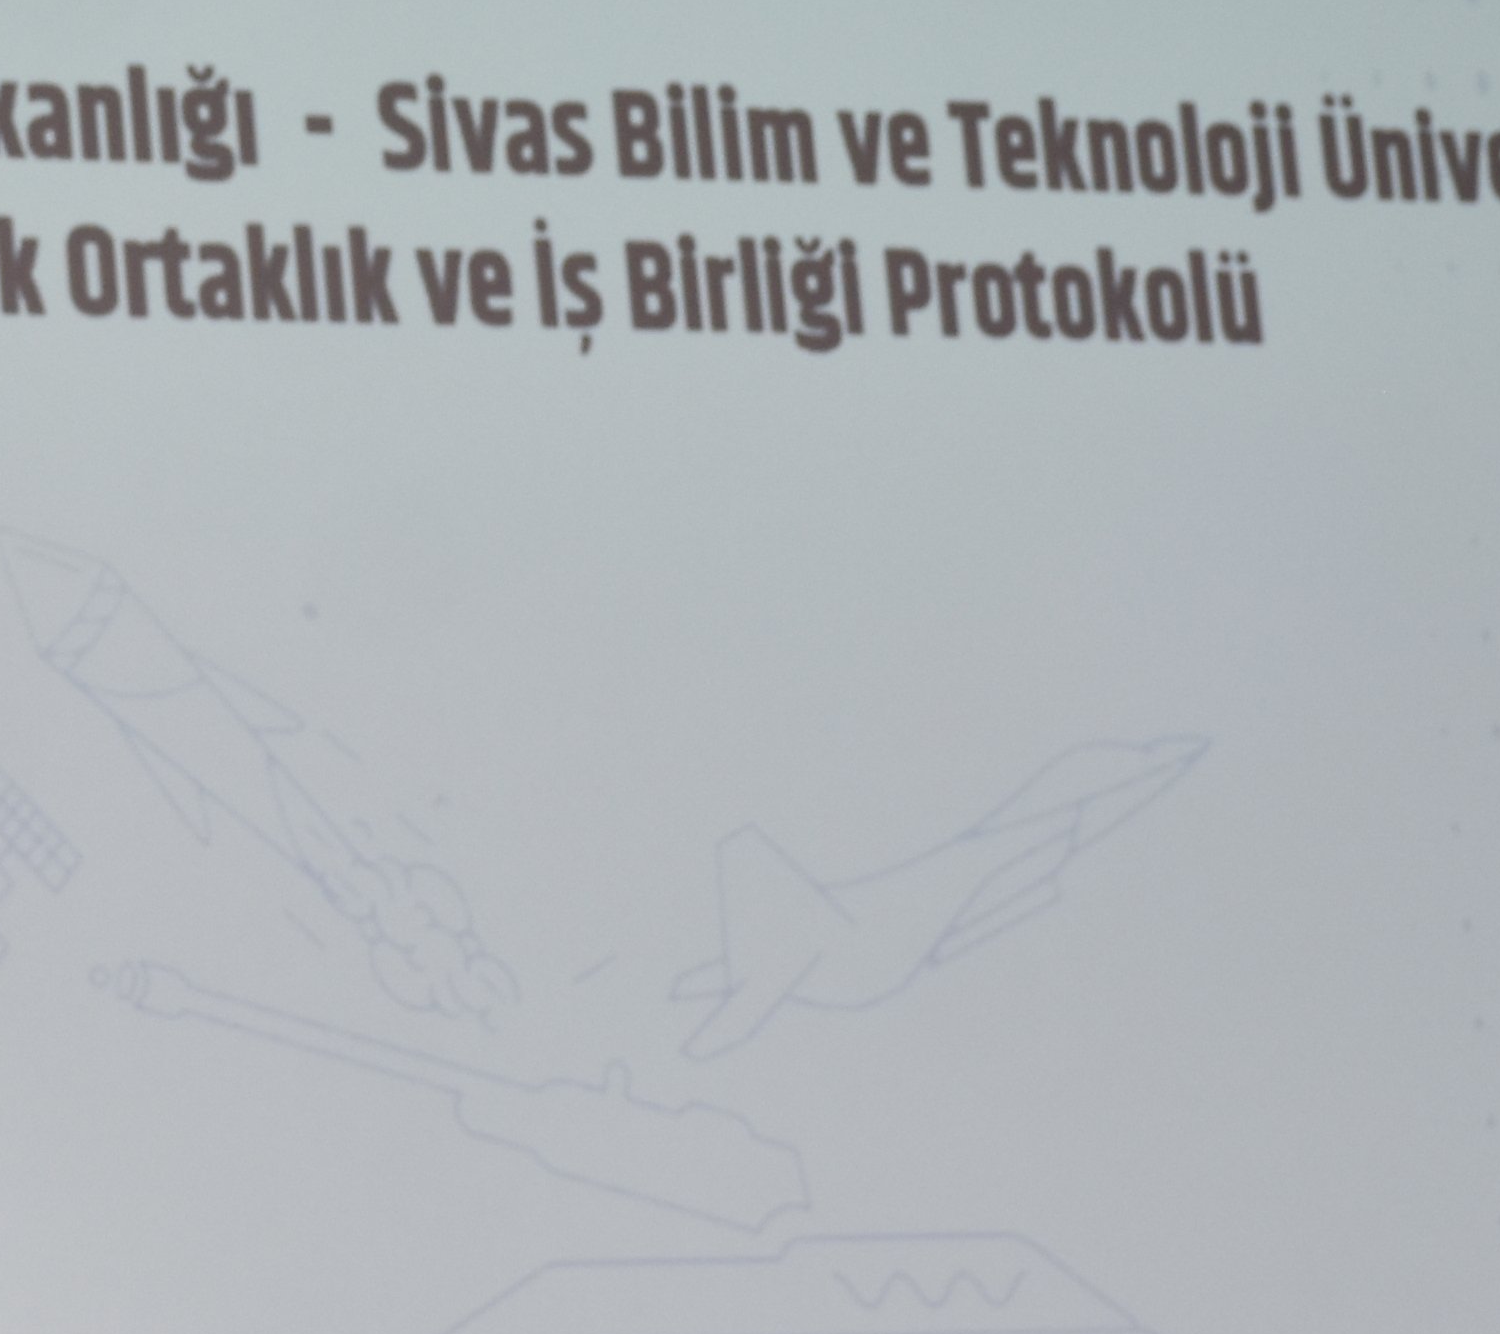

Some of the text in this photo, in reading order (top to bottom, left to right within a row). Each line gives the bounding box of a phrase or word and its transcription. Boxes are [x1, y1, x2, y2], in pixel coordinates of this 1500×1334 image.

[377, 73, 594, 176] Sivas
[611, 82, 818, 184] Bilim
[836, 110, 932, 187] ve
[946, 96, 1302, 214] Teknoloji
[66, 223, 399, 324] Ortaklık
[415, 248, 513, 327] ve
[534, 218, 604, 354] İş
[624, 233, 869, 354] Birliği
[884, 247, 1264, 345] Protokolü
